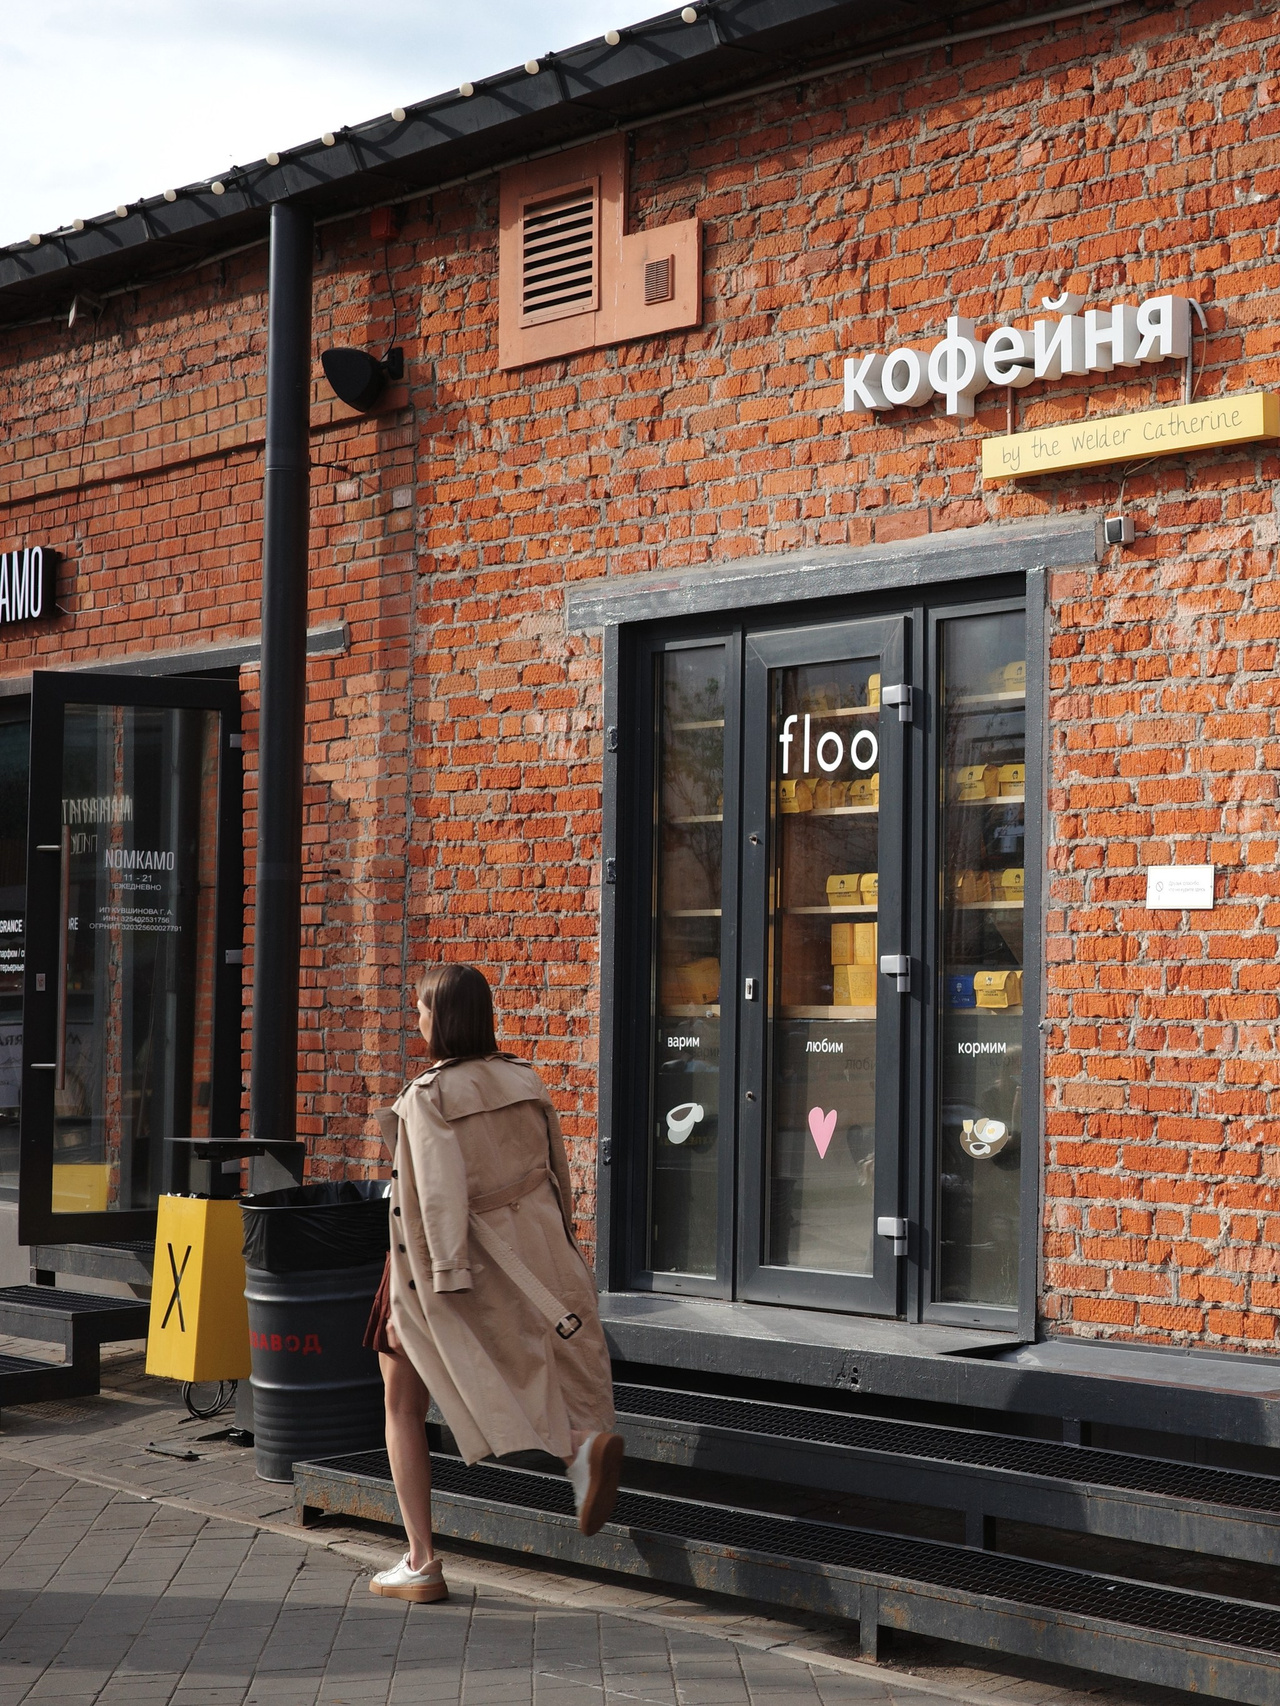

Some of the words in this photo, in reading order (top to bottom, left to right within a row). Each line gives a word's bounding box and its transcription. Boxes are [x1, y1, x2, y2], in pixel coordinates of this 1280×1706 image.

[844, 292, 1187, 418] кофейня
[1002, 446, 1021, 471] by
[1031, 435, 1061, 458] the
[1072, 424, 1131, 452] Welder
[1143, 410, 1243, 441] Catherine
[0, 546, 43, 623] AMO
[779, 713, 879, 774] floo
[105, 849, 175, 871] NOMKAMO
[142, 874, 153, 882] 21
[113, 883, 161, 891] ЕЖЕДНЕВНО
[111, 907, 158, 915] КУВШИНОВА
[121, 915, 170, 923] 325402531756
[667, 1035, 700, 1051] варим
[805, 1039, 844, 1054] любим
[958, 1040, 1007, 1057] кормим
[249, 1330, 323, 1356] ЗАВОД
